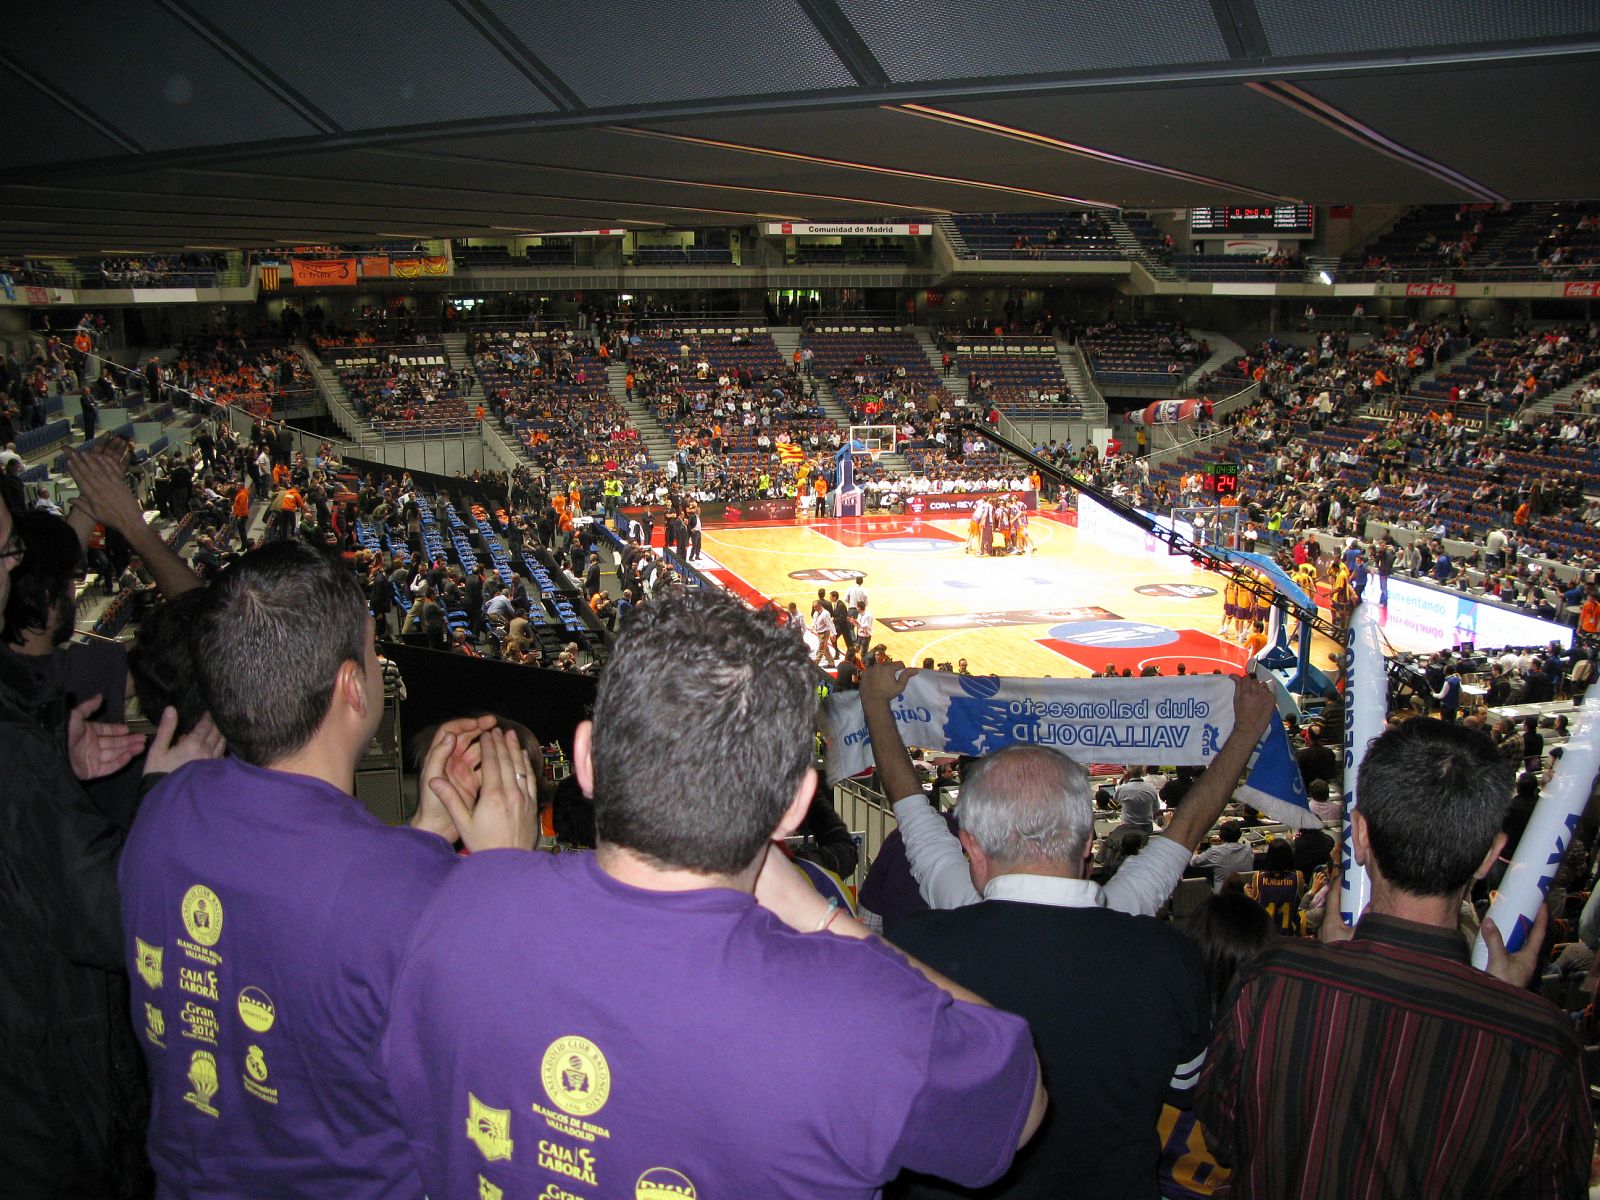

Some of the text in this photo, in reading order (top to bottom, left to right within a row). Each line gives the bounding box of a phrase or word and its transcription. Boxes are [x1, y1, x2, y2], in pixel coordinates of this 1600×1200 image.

[865, 402, 878, 413] 24
[1217, 476, 1235, 491] 24
[930, 502, 950, 510] COPA
[181, 967, 203, 985] CAJA
[180, 979, 219, 1001] LABORAL
[186, 1001, 214, 1018] Gran
[567, 1040, 591, 1053] CLUB
[532, 1102, 570, 1125] BLANCOS
[546, 1117, 596, 1143] VALLADOLID
[538, 1139, 574, 1164] CAJA
[537, 1152, 598, 1186] LABORAL
